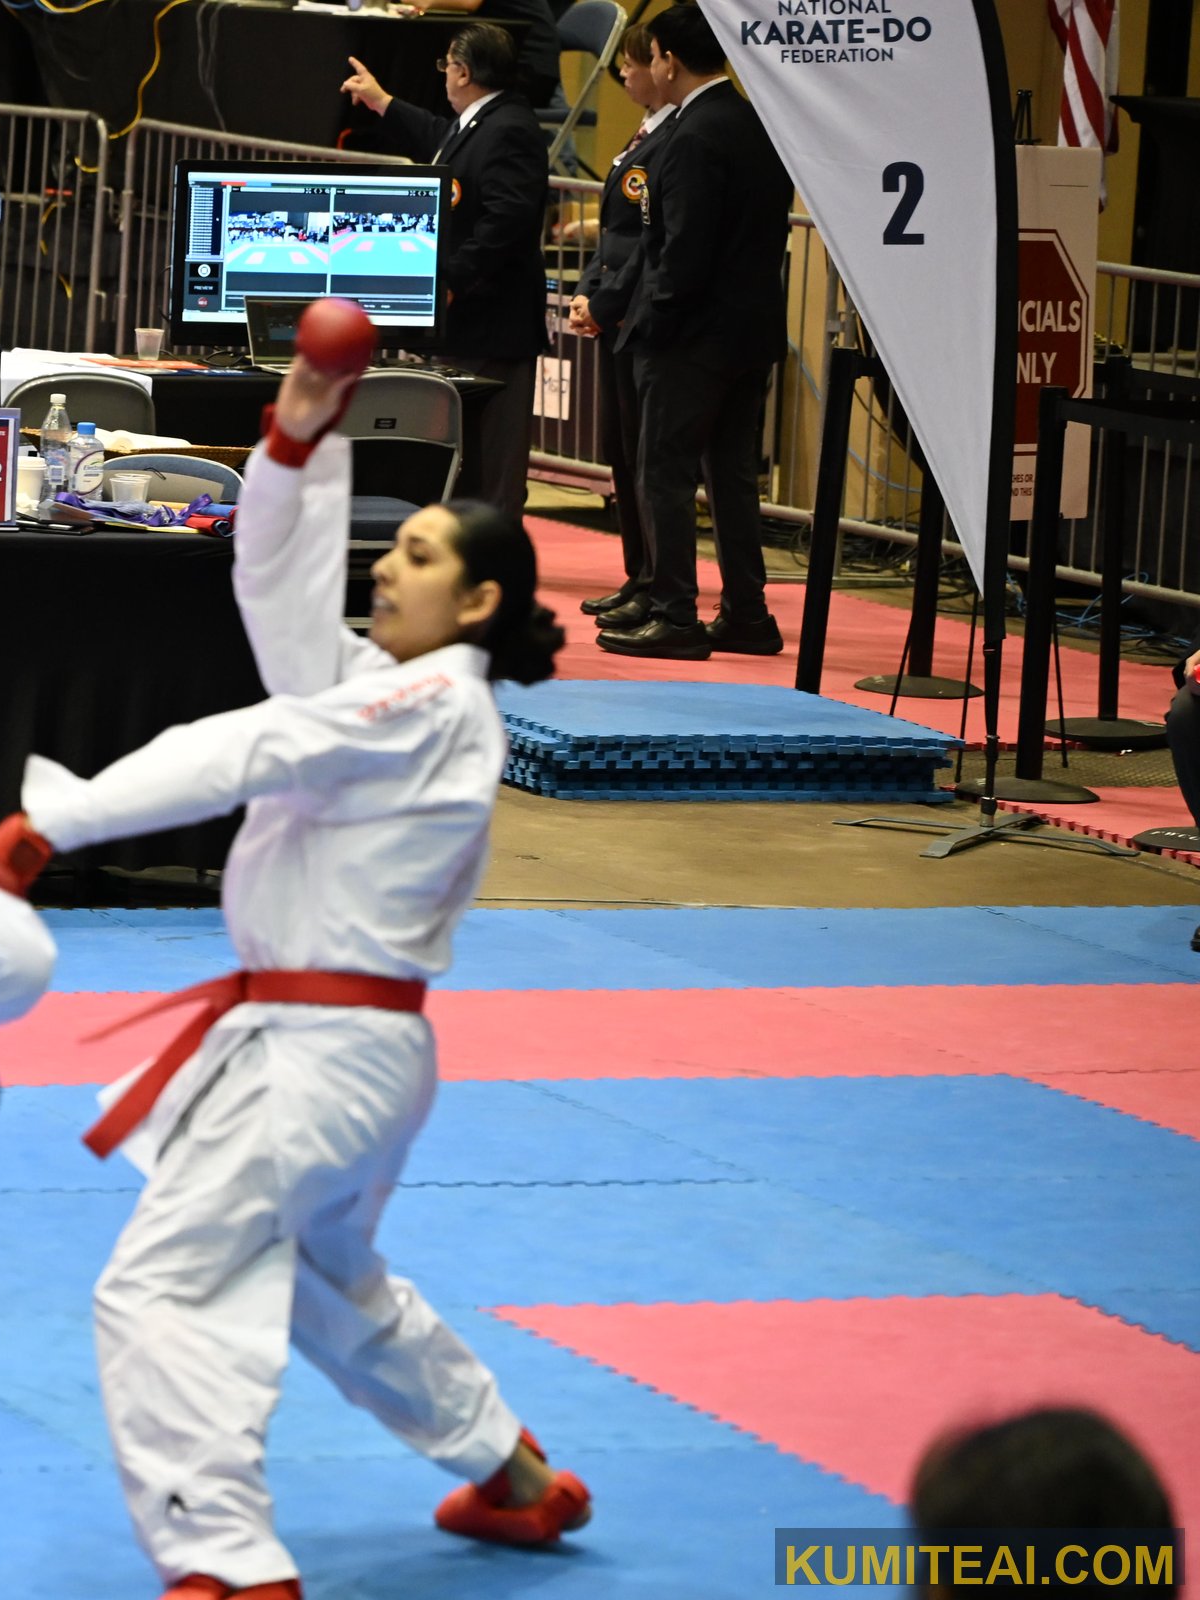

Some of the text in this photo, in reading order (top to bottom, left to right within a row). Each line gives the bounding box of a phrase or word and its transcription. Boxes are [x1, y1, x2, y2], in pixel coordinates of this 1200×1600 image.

[778, 0, 892, 16] NATIONAL
[741, 16, 932, 45] KARATE-DO
[781, 48, 893, 63] FEDERATION
[882, 161, 924, 245] 2
